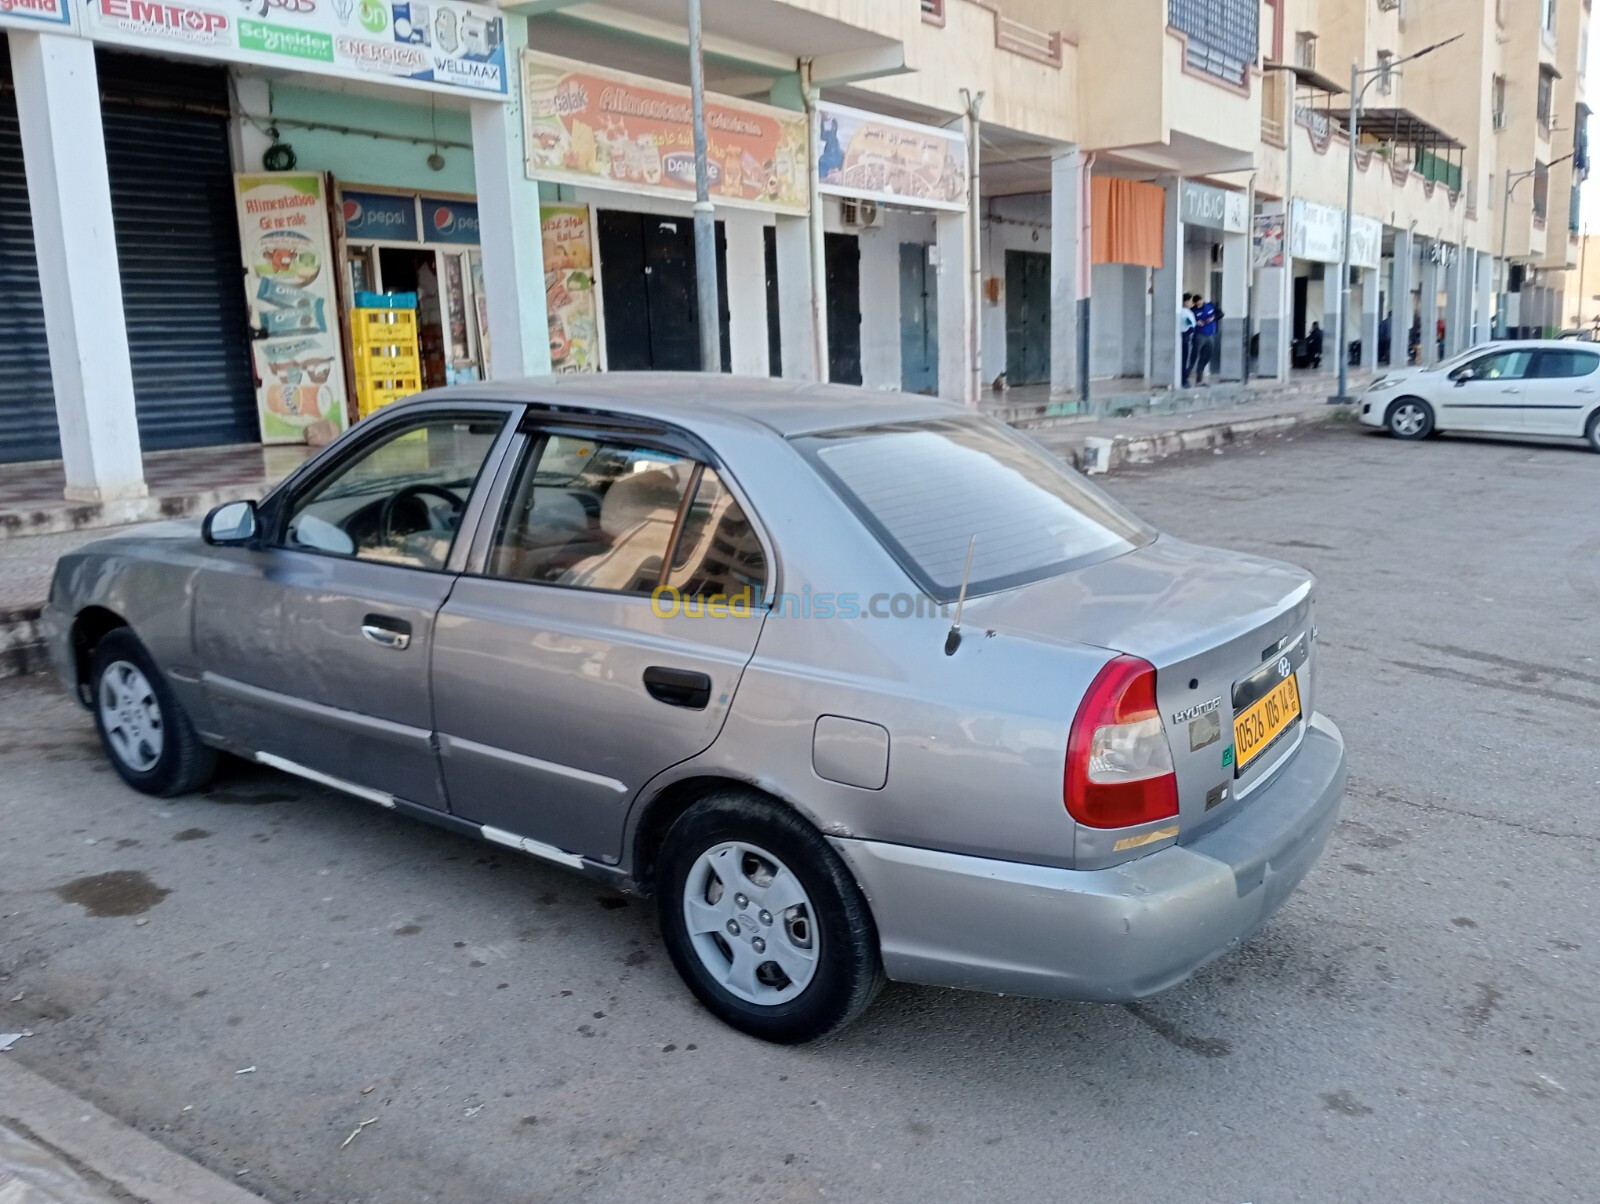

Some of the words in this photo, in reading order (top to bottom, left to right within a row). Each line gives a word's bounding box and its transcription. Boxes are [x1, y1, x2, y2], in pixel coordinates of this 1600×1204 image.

[100, 0, 227, 33] EMTOP
[240, 22, 330, 50] Schneider
[281, 43, 330, 58] Electric
[434, 56, 498, 80] WELLMAX
[554, 89, 588, 113] Galak
[600, 86, 695, 124] Alimentatio
[246, 194, 315, 214] Alimentation
[1186, 188, 1223, 220] TABAC
[367, 210, 405, 225] pepsi
[458, 217, 480, 232] pep
[1235, 709, 1265, 755] 10526
[1265, 694, 1280, 730] 105
[1280, 686, 1289, 716] 14
